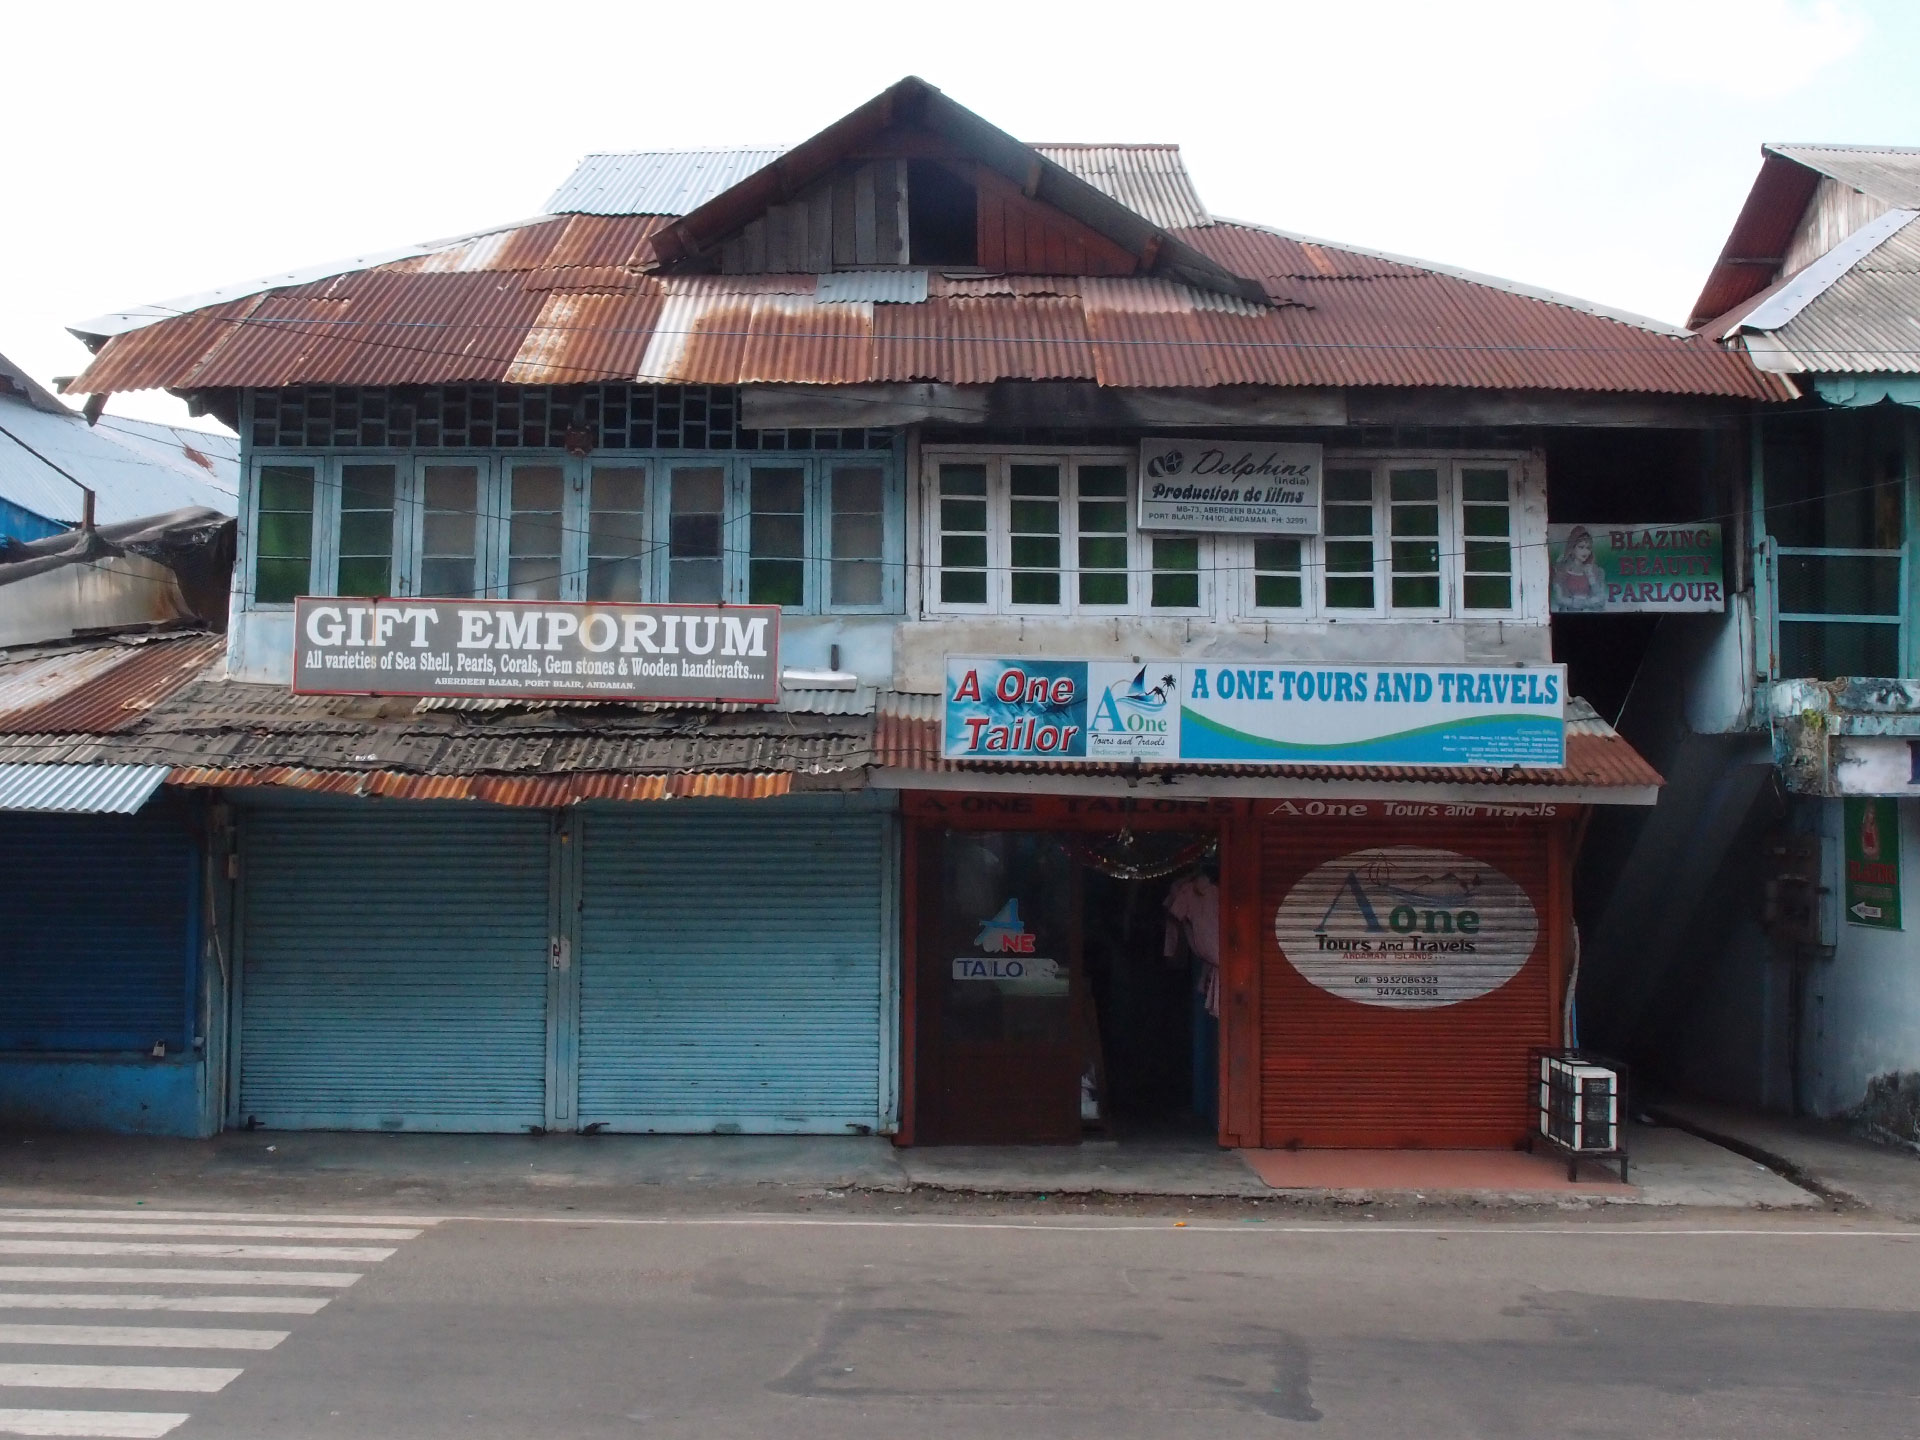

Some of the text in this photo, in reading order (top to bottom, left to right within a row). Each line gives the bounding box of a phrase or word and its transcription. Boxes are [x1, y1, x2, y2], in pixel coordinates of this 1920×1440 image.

[1191, 449, 1312, 483] Delphine
[1274, 477, 1309, 487] (India)
[1152, 482, 1240, 503] Production
[1264, 486, 1305, 504] films
[1148, 512, 1170, 521] PORT
[1171, 513, 1194, 522] BLAIR
[1201, 514, 1228, 524] 744101,
[1204, 507, 1245, 515] ABERDEEN
[1246, 507, 1279, 517] BAZAAR,
[1609, 530, 1712, 550] BLAZING
[1619, 555, 1713, 576] BEAUTY
[1607, 582, 1722, 603] PARLOUR
[306, 607, 769, 658] GIFT EMPORIUM
[305, 651, 322, 669] All
[324, 653, 377, 670] varieties
[380, 652, 394, 670] of
[395, 652, 417, 671] Sea
[420, 653, 454, 675] Shell,
[457, 653, 498, 676] Pearls,
[500, 654, 542, 677] Corals,
[545, 655, 574, 675] Gem
[576, 658, 615, 676] stones
[617, 658, 629, 676] &
[631, 657, 679, 677] Wooden
[435, 677, 486, 686] ABERDEEN
[488, 679, 523, 688] BAZAR,
[553, 681, 585, 690] BLAIR,
[586, 681, 636, 690] ANDAMAN.
[953, 668, 1075, 702] A One
[1192, 669, 1558, 705] A ONE TOURS AND TRAVELS
[1088, 685, 1167, 732] A One
[965, 717, 1078, 750] Tailor
[1092, 735, 1165, 746] Tours and Travels
[1383, 802, 1438, 816] Tours
[1389, 905, 1480, 934] One
[1315, 934, 1475, 952] Tours And Travels
[1342, 952, 1387, 960] ANDAMAN
